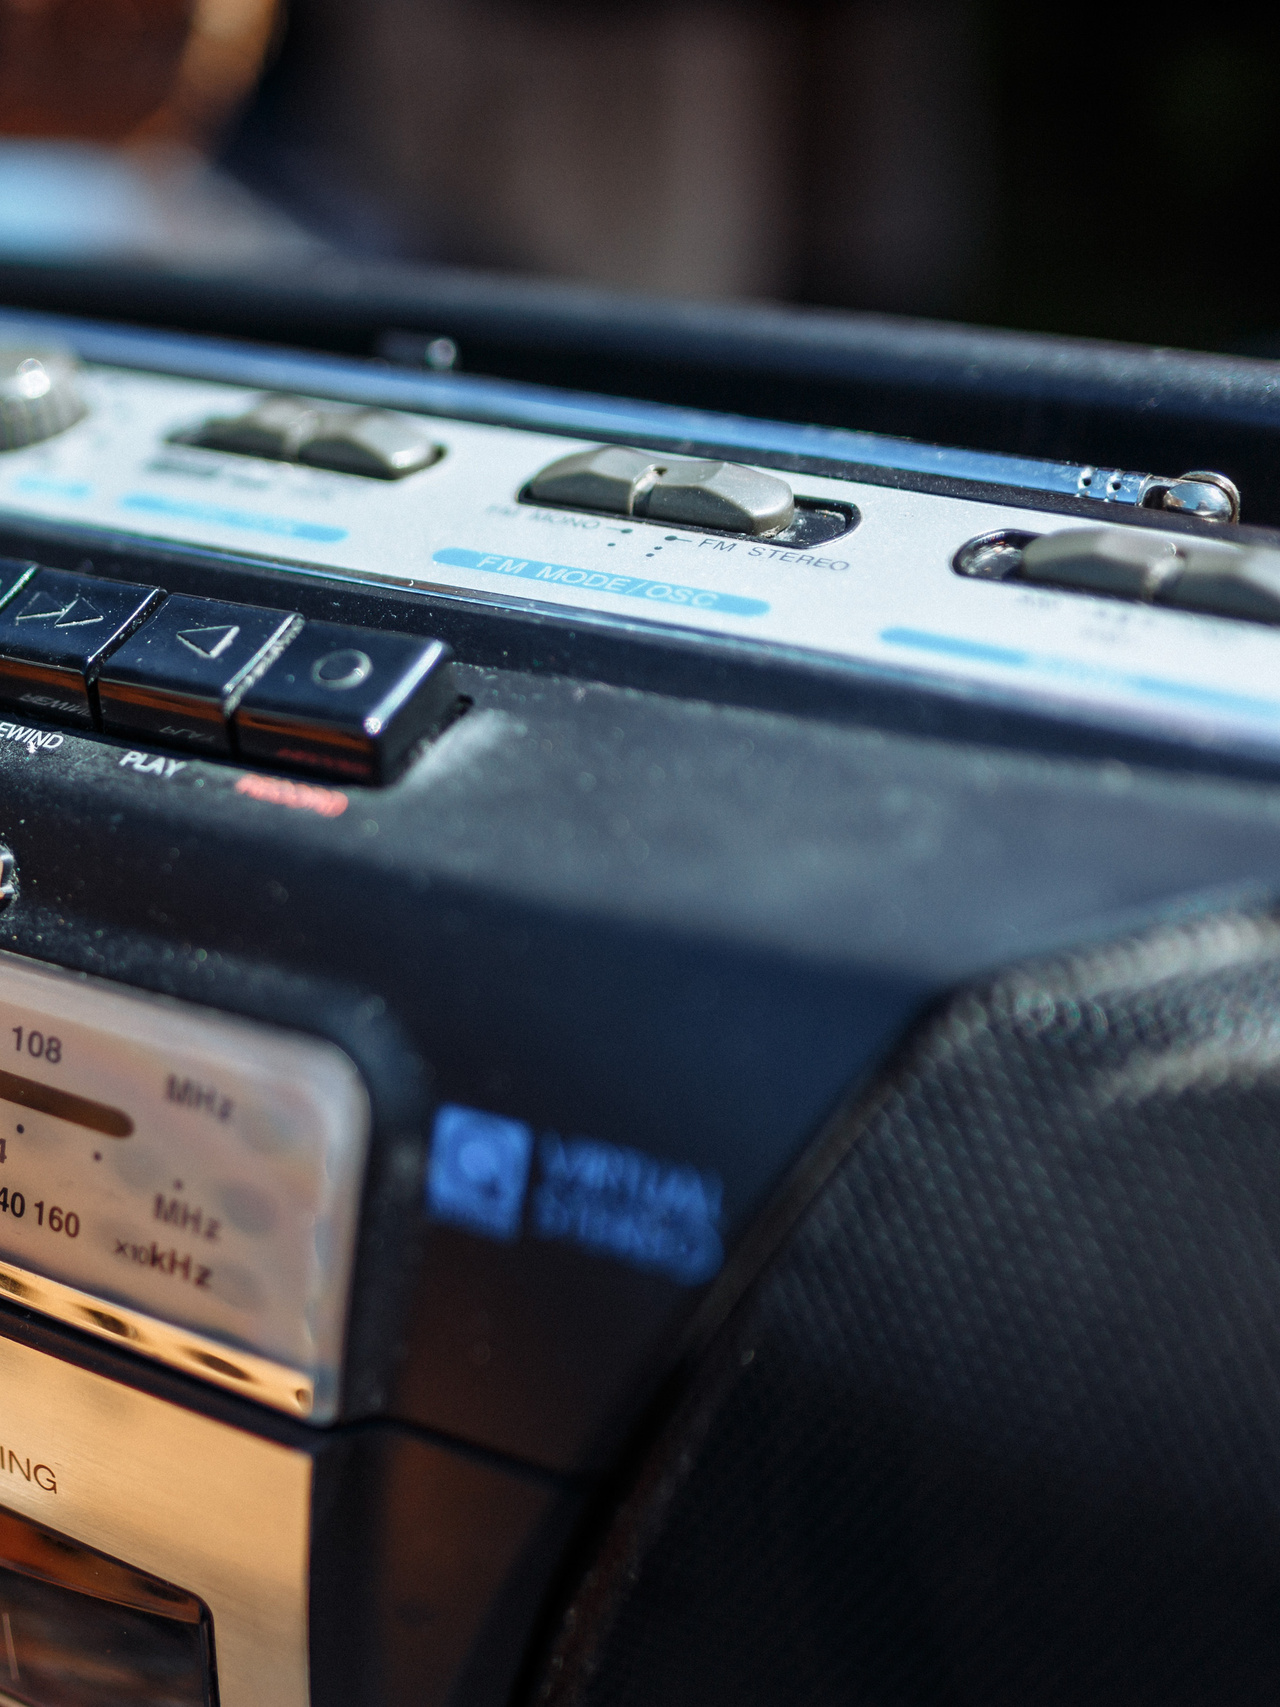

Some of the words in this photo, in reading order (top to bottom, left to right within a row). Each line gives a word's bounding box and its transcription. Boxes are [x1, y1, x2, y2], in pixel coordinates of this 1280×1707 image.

[698, 538, 737, 553] FM
[747, 546, 851, 572] STEREO
[476, 555, 528, 575] FM
[534, 566, 719, 609] MODE/OSC
[119, 750, 187, 779] PLAY
[12, 1025, 63, 1065] 108
[33, 1200, 80, 1239] 160
[153, 1192, 220, 1242] MHz
